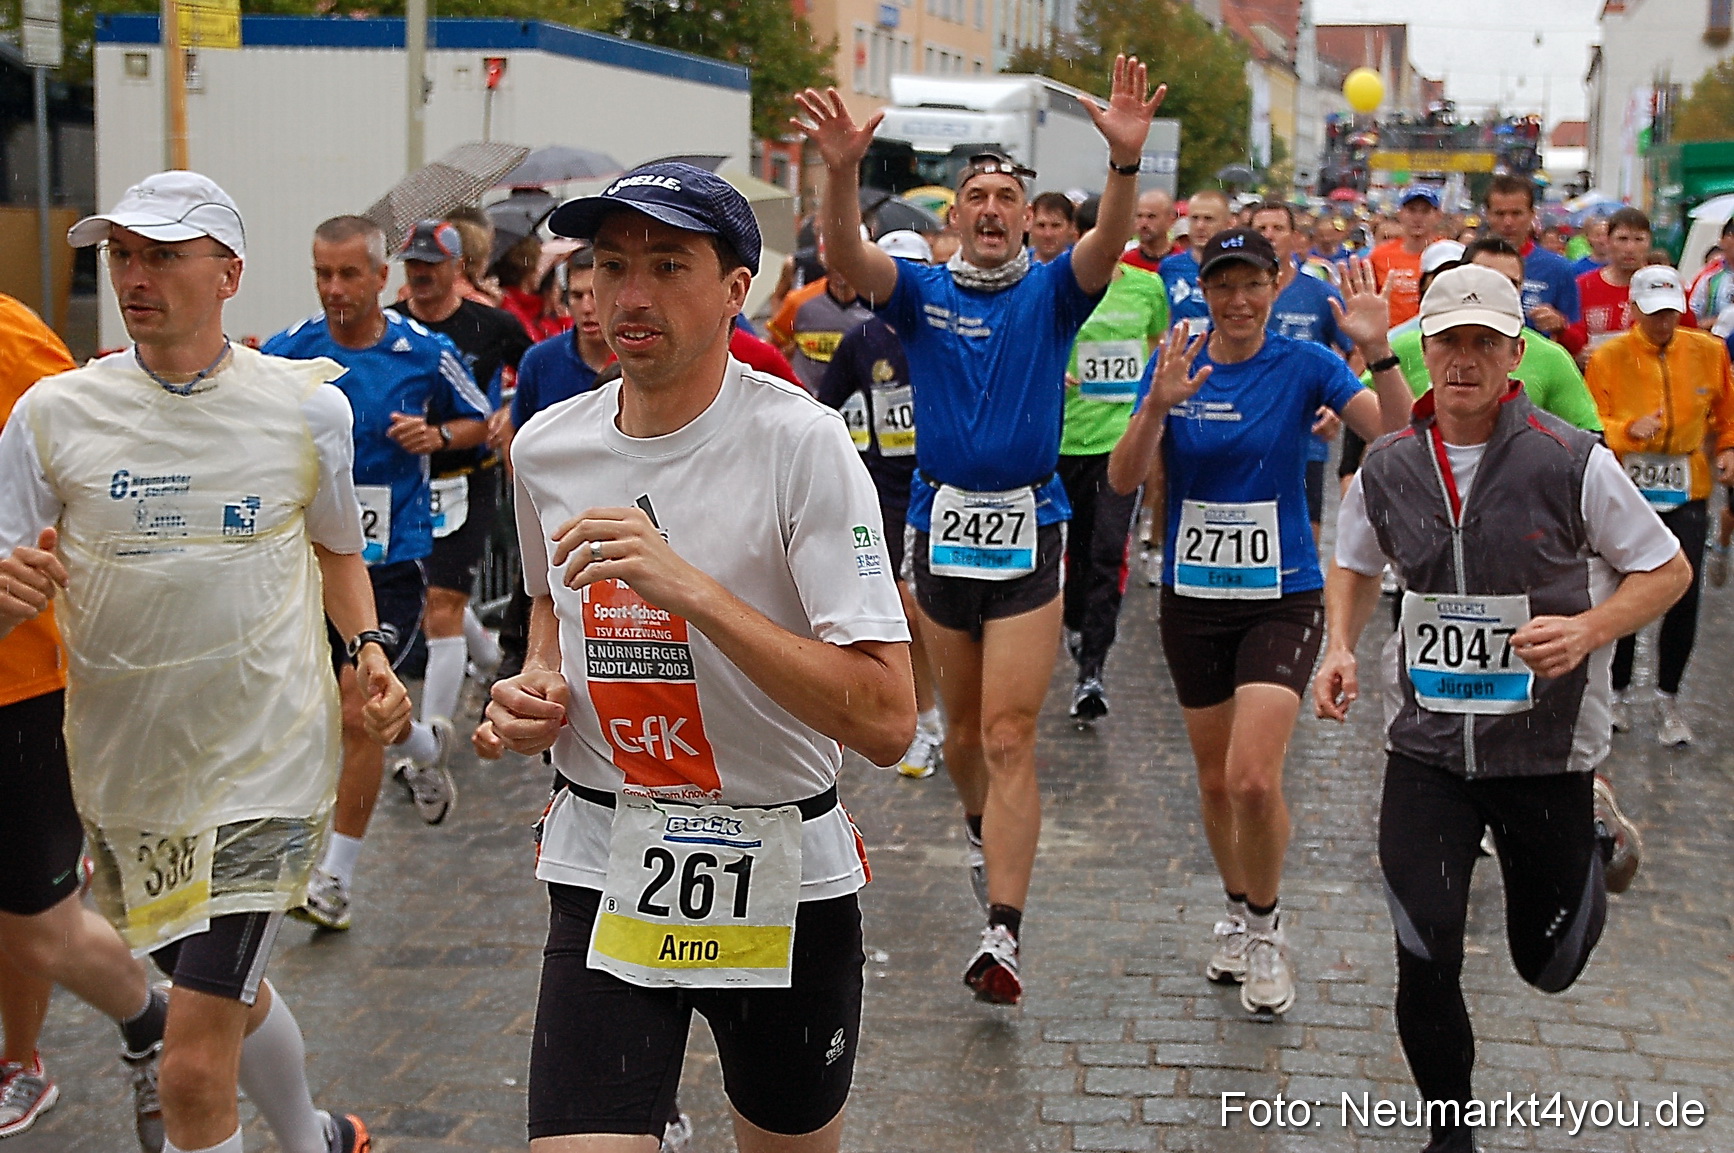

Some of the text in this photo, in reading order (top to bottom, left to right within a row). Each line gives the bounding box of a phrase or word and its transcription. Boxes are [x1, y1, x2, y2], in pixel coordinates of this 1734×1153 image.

[1085, 357, 1138, 379] 3120
[942, 510, 1025, 545] 2427
[1186, 527, 1269, 564] 2710
[595, 627, 672, 640] TSV KATZWANG
[1417, 623, 1517, 669] 2047
[589, 660, 689, 676] STADTLAUF 2003
[1438, 677, 1494, 698] Jürgen
[609, 715, 700, 761] GfK
[665, 815, 743, 836] BOCK
[636, 846, 756, 920] 261
[607, 898, 616, 912] B
[658, 933, 720, 962] Arno
